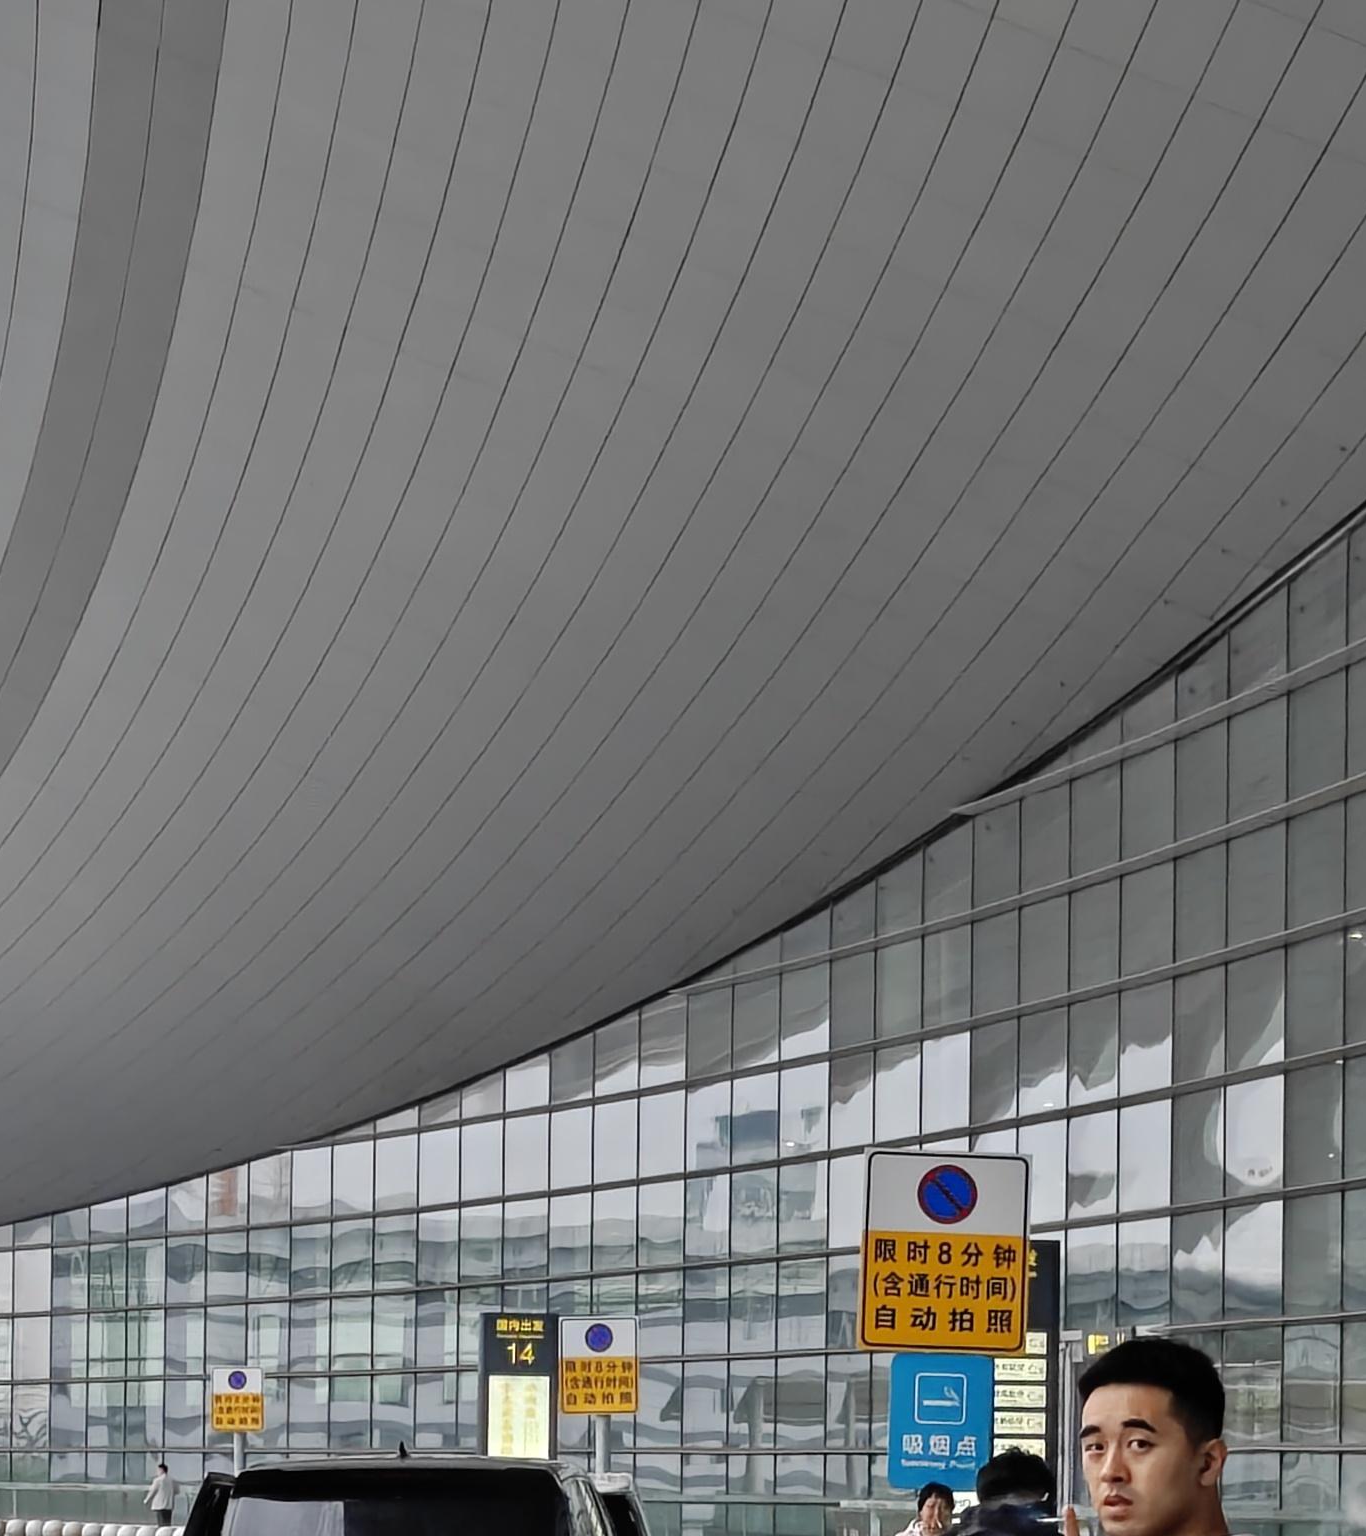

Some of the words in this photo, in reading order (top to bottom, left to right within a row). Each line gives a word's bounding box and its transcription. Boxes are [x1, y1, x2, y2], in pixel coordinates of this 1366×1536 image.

[873, 1238, 1017, 1269] 限时8分钟
[873, 1271, 1018, 1302] (含通行时间)
[874, 1305, 1013, 1335] 自动拍照
[506, 1342, 536, 1366] 14
[902, 1434, 977, 1457] 吸烟点
